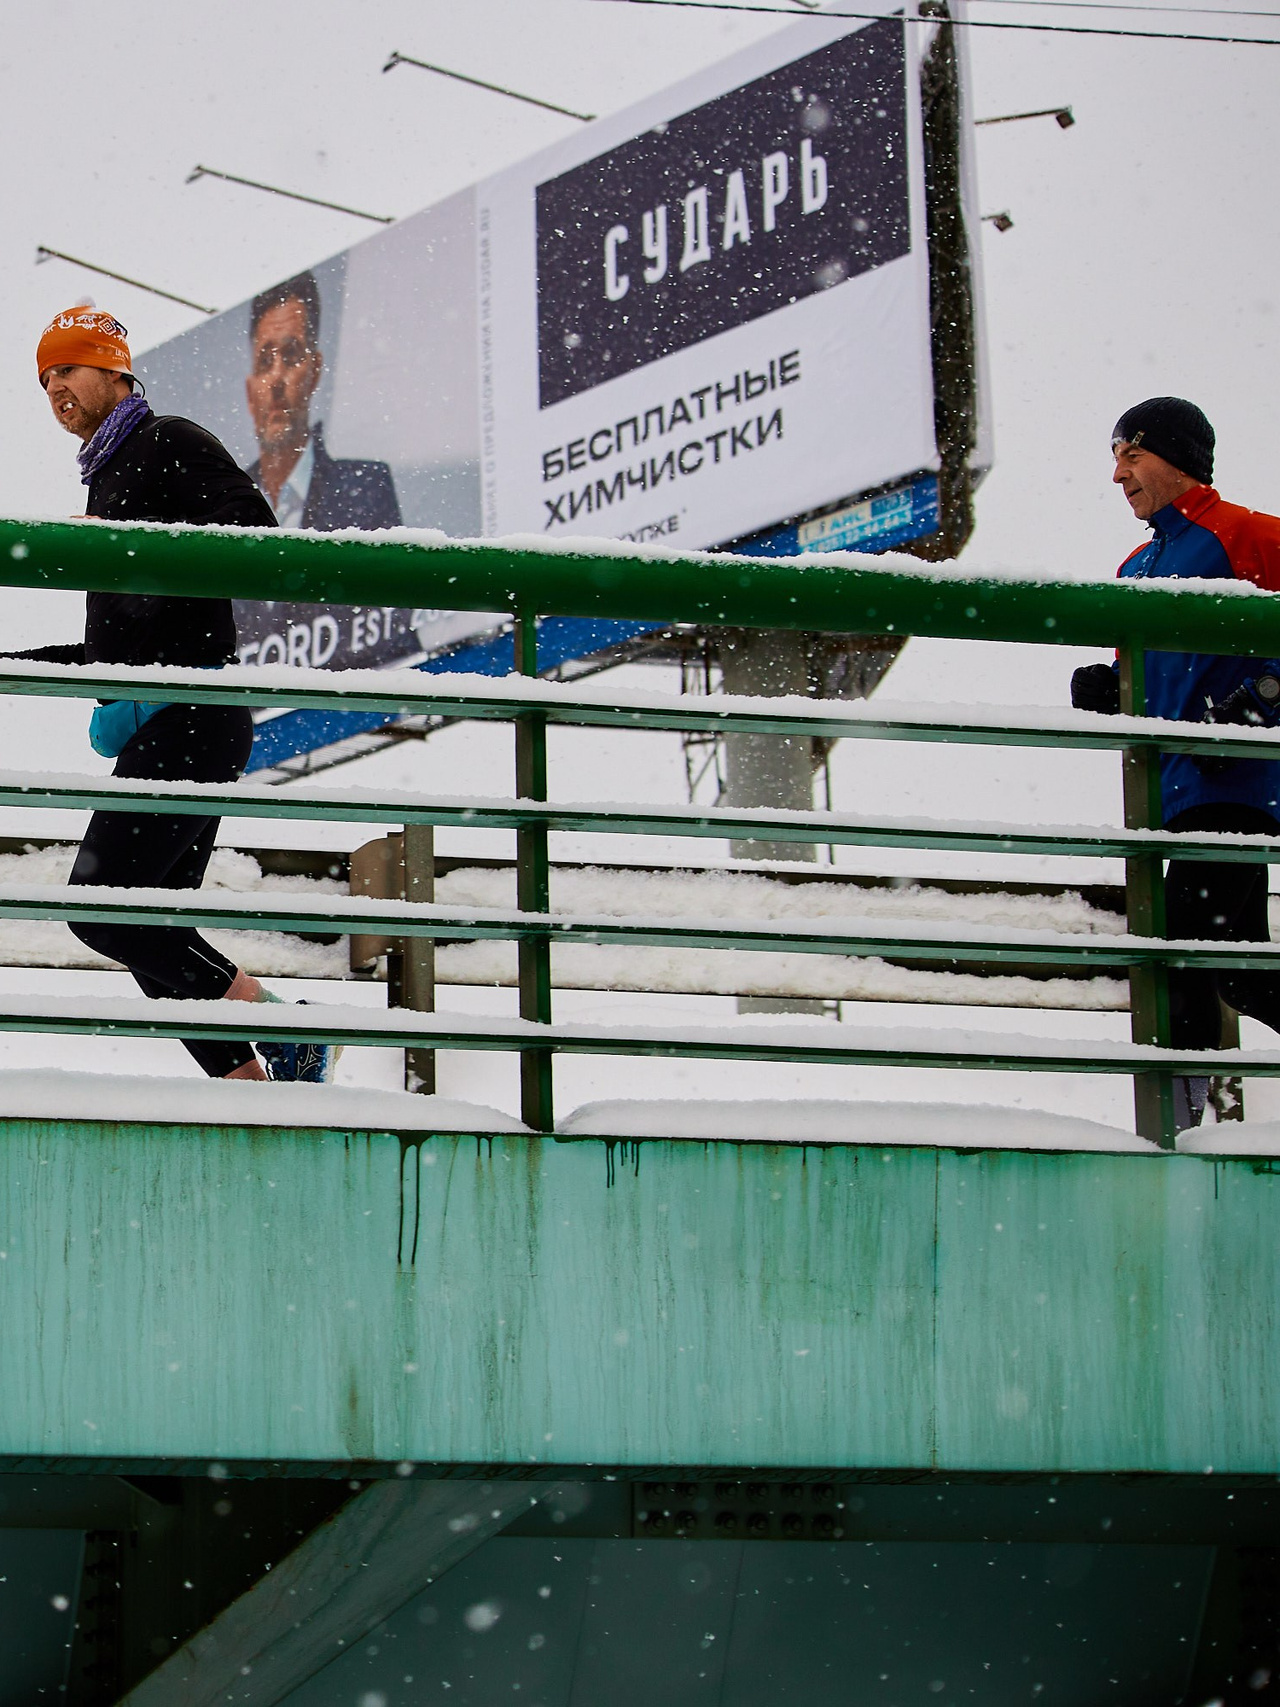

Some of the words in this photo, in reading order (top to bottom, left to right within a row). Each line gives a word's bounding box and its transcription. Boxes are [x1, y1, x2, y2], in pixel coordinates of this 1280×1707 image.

[603, 138, 829, 302] СУДАРЬ
[542, 349, 800, 483] БЕСПЛАТНЫЕ
[544, 408, 783, 530] ХИМЧИСТКИ
[350, 606, 406, 653] EST.
